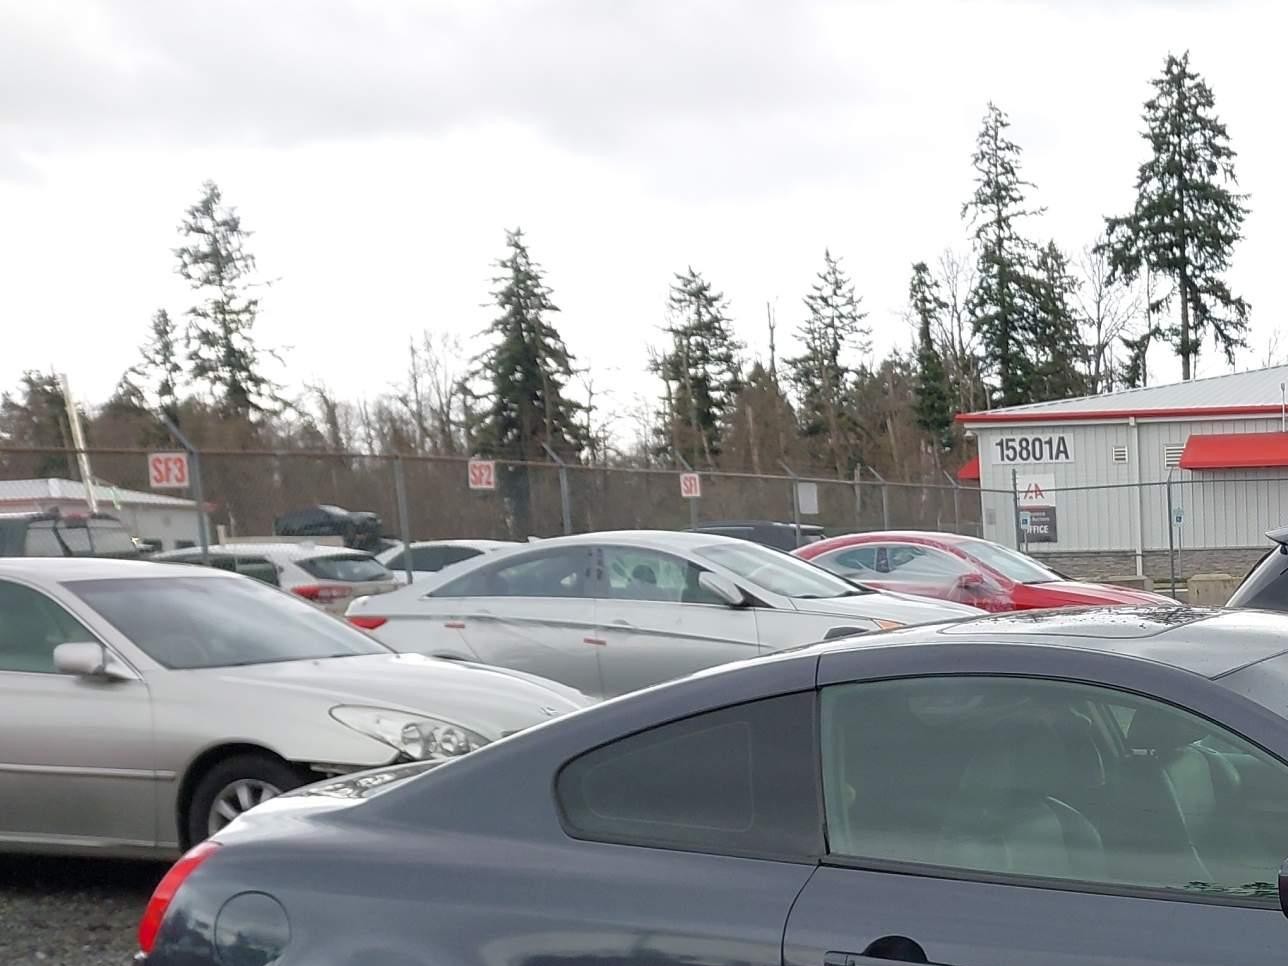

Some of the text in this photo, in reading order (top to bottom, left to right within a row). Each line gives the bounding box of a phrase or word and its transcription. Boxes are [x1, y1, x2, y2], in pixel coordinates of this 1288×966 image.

[995, 436, 1070, 462] 15801A
[152, 457, 186, 483] SF3
[471, 464, 492, 486] SF2
